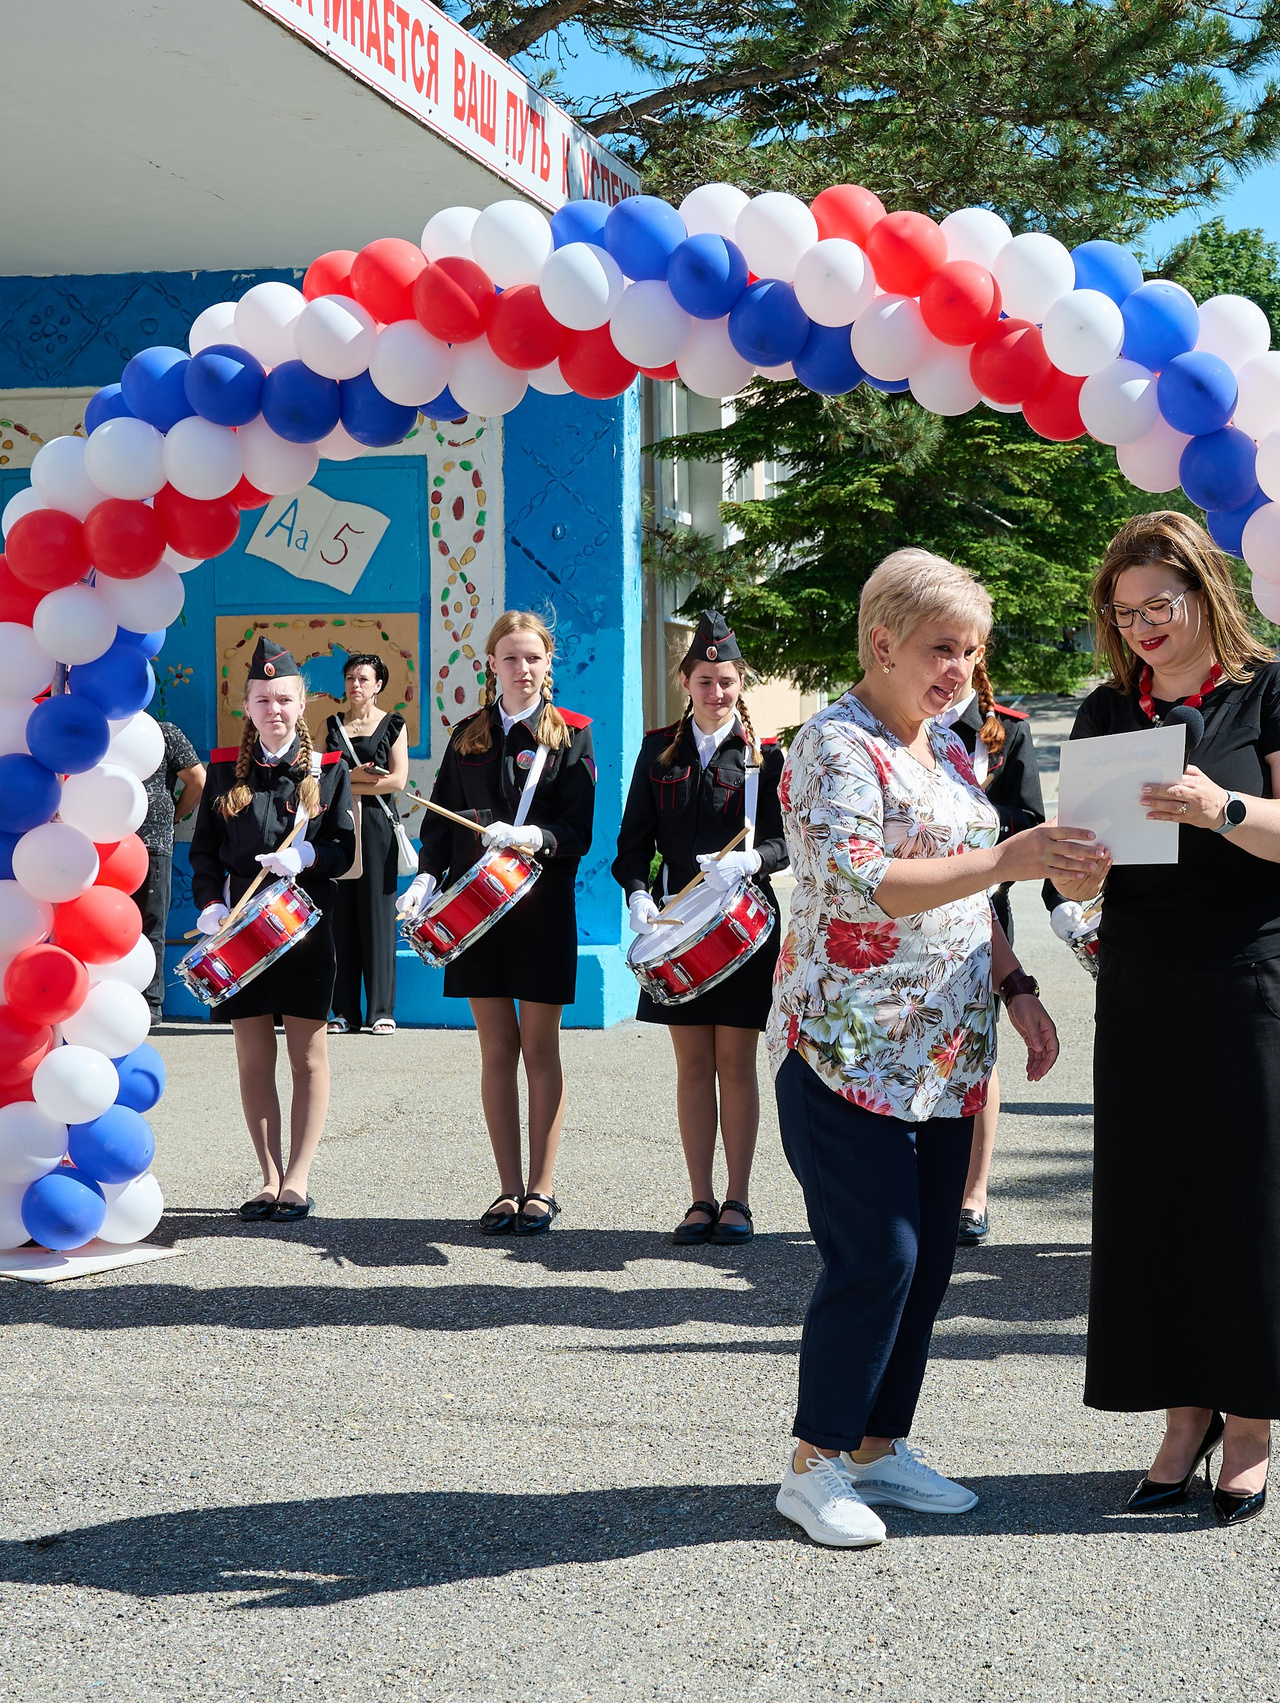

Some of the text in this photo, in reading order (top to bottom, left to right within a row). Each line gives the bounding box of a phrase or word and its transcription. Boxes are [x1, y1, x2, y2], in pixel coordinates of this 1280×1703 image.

[291, 0, 639, 208] ИНАЕТСЯ ВАШ ПУТЬ К УСПЕ
[319, 522, 365, 565] 5
